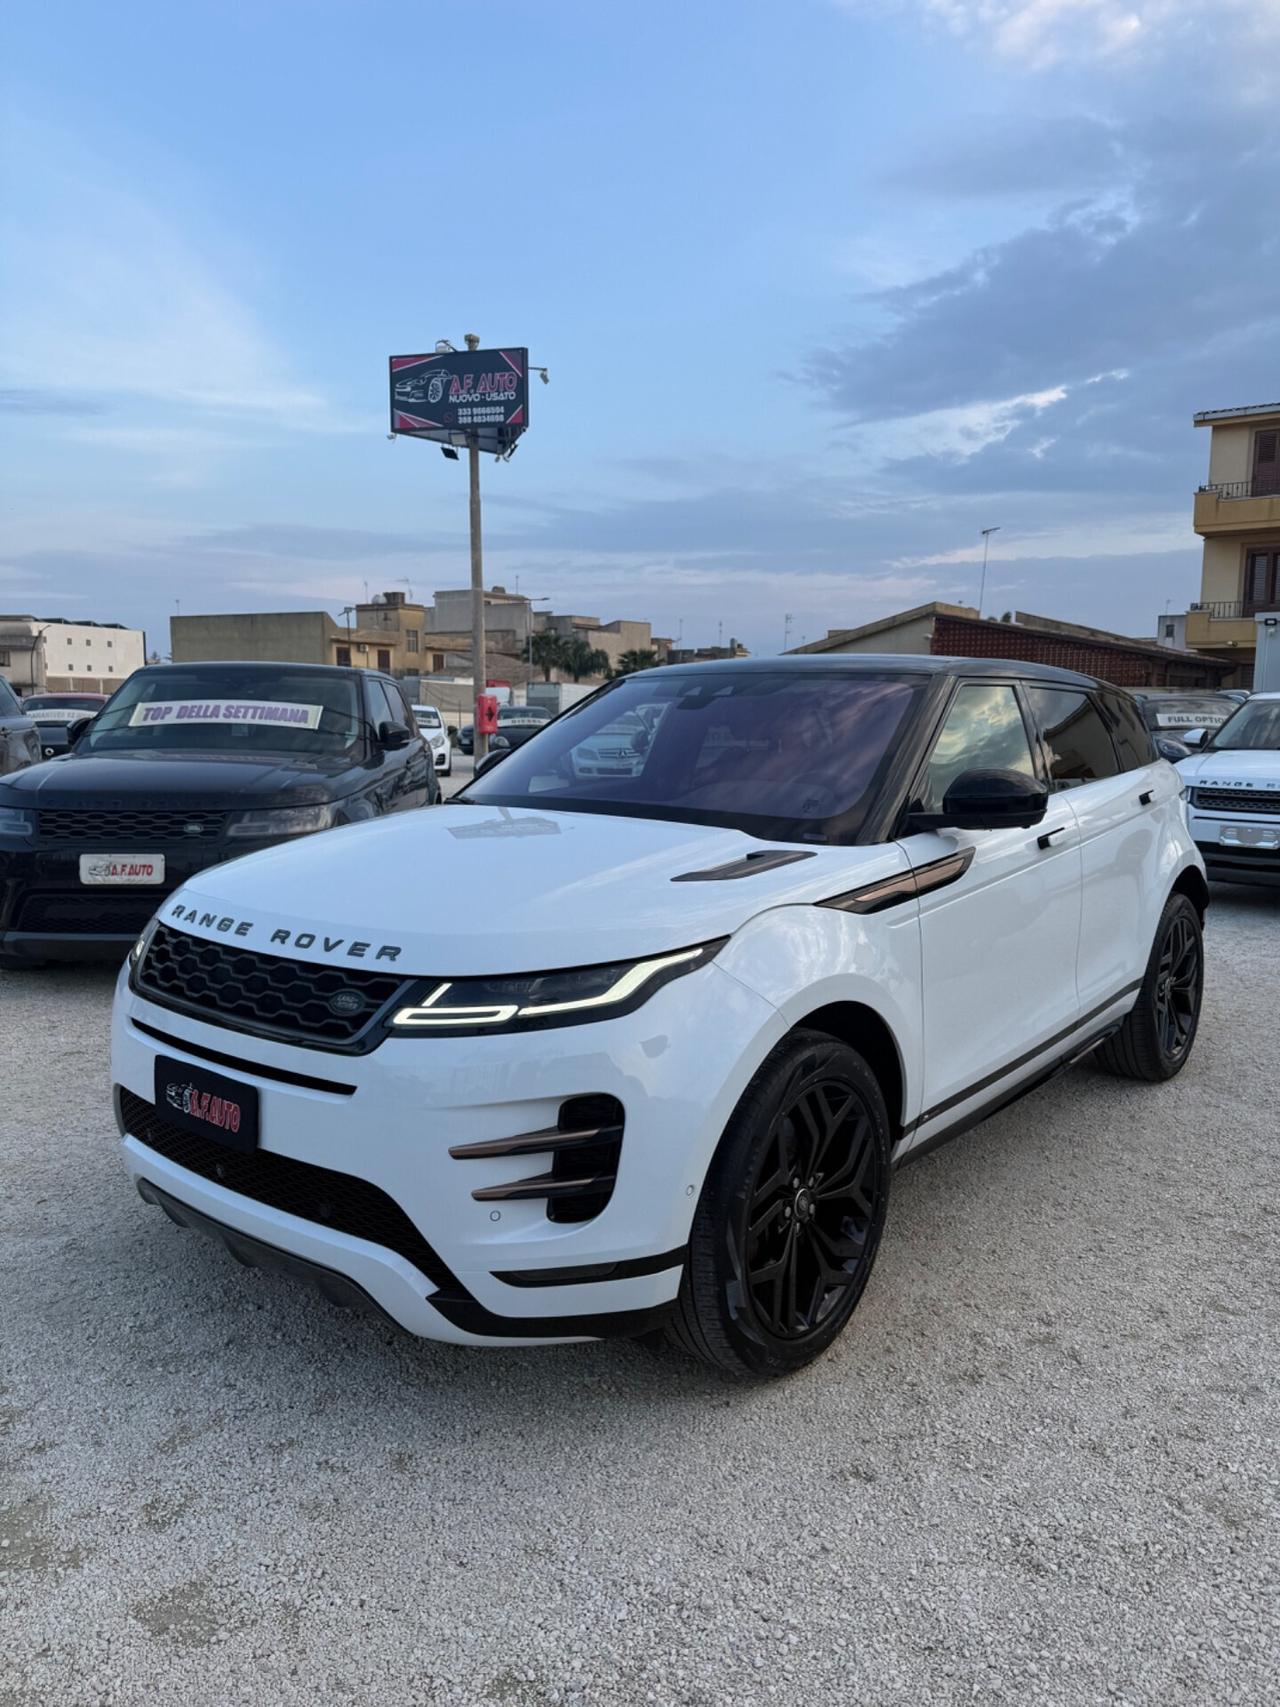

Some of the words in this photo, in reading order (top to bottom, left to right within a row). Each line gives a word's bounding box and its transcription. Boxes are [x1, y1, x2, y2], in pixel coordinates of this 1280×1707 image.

[476, 372, 517, 393] AUTO
[449, 393, 480, 402] NUOVO
[486, 391, 516, 401] USATO
[143, 706, 173, 721] TOP
[176, 705, 221, 720] DELLA
[223, 705, 309, 724] SETTIMANA
[171, 904, 254, 937] RANGE
[270, 928, 402, 962] ROVER
